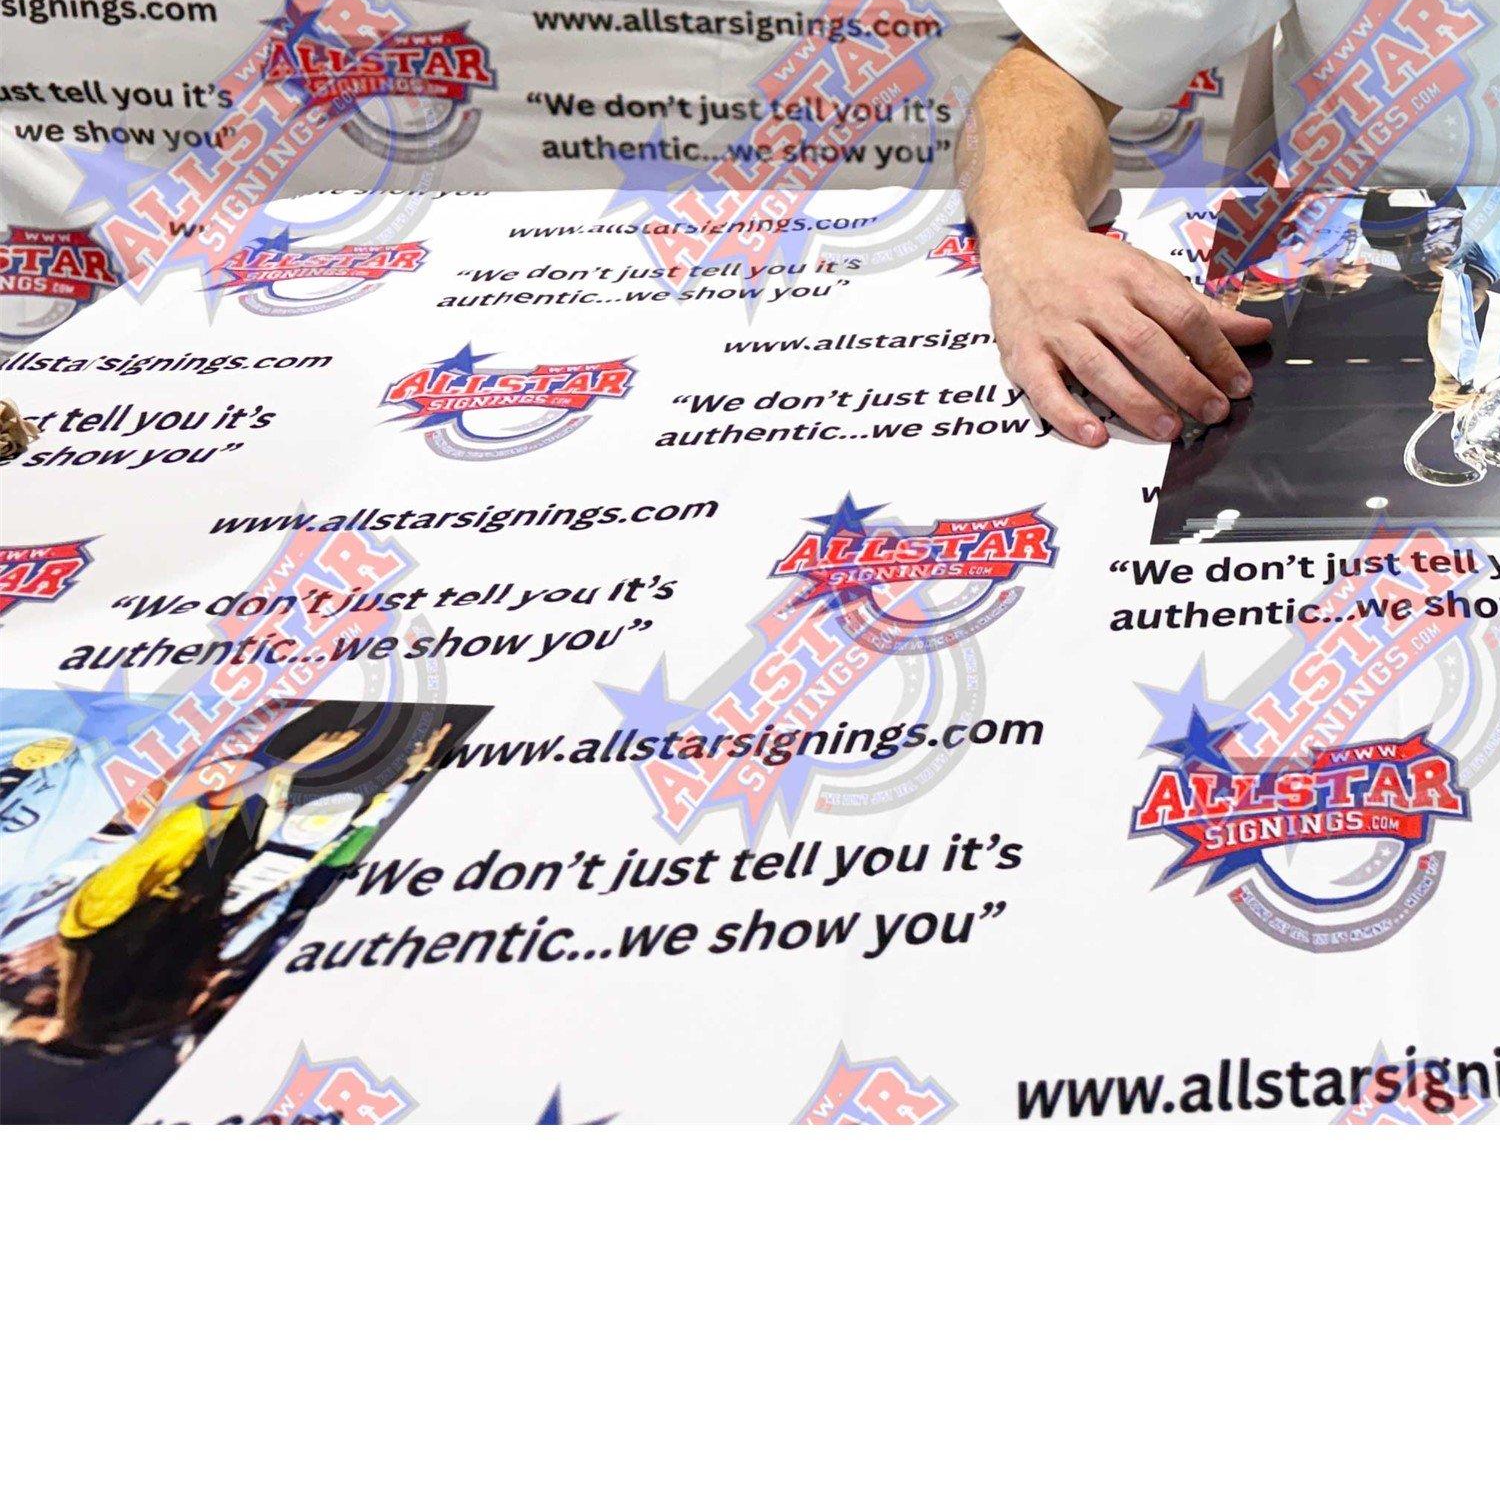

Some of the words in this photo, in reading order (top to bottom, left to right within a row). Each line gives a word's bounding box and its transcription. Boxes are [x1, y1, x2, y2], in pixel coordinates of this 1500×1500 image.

[532, 7, 943, 43] www.allstarsignings.com
[383, 366, 634, 403] ALLSTAR
[672, 394, 745, 414] “We
[852, 388, 929, 413] just
[938, 384, 997, 405] tell
[931, 416, 1031, 437] show
[209, 500, 719, 534] www.allstarsignings.com
[773, 523, 1052, 577] ALLSTAR
[1322, 552, 1401, 586] just
[1410, 549, 1479, 574] tell
[335, 588, 429, 614] just
[433, 583, 515, 608] tell
[506, 587, 600, 612] you
[403, 626, 533, 660] show
[442, 719, 1044, 767] www.allstarsignings.com
[1133, 755, 1465, 831] ALLSTAR
[708, 908, 861, 954] show
